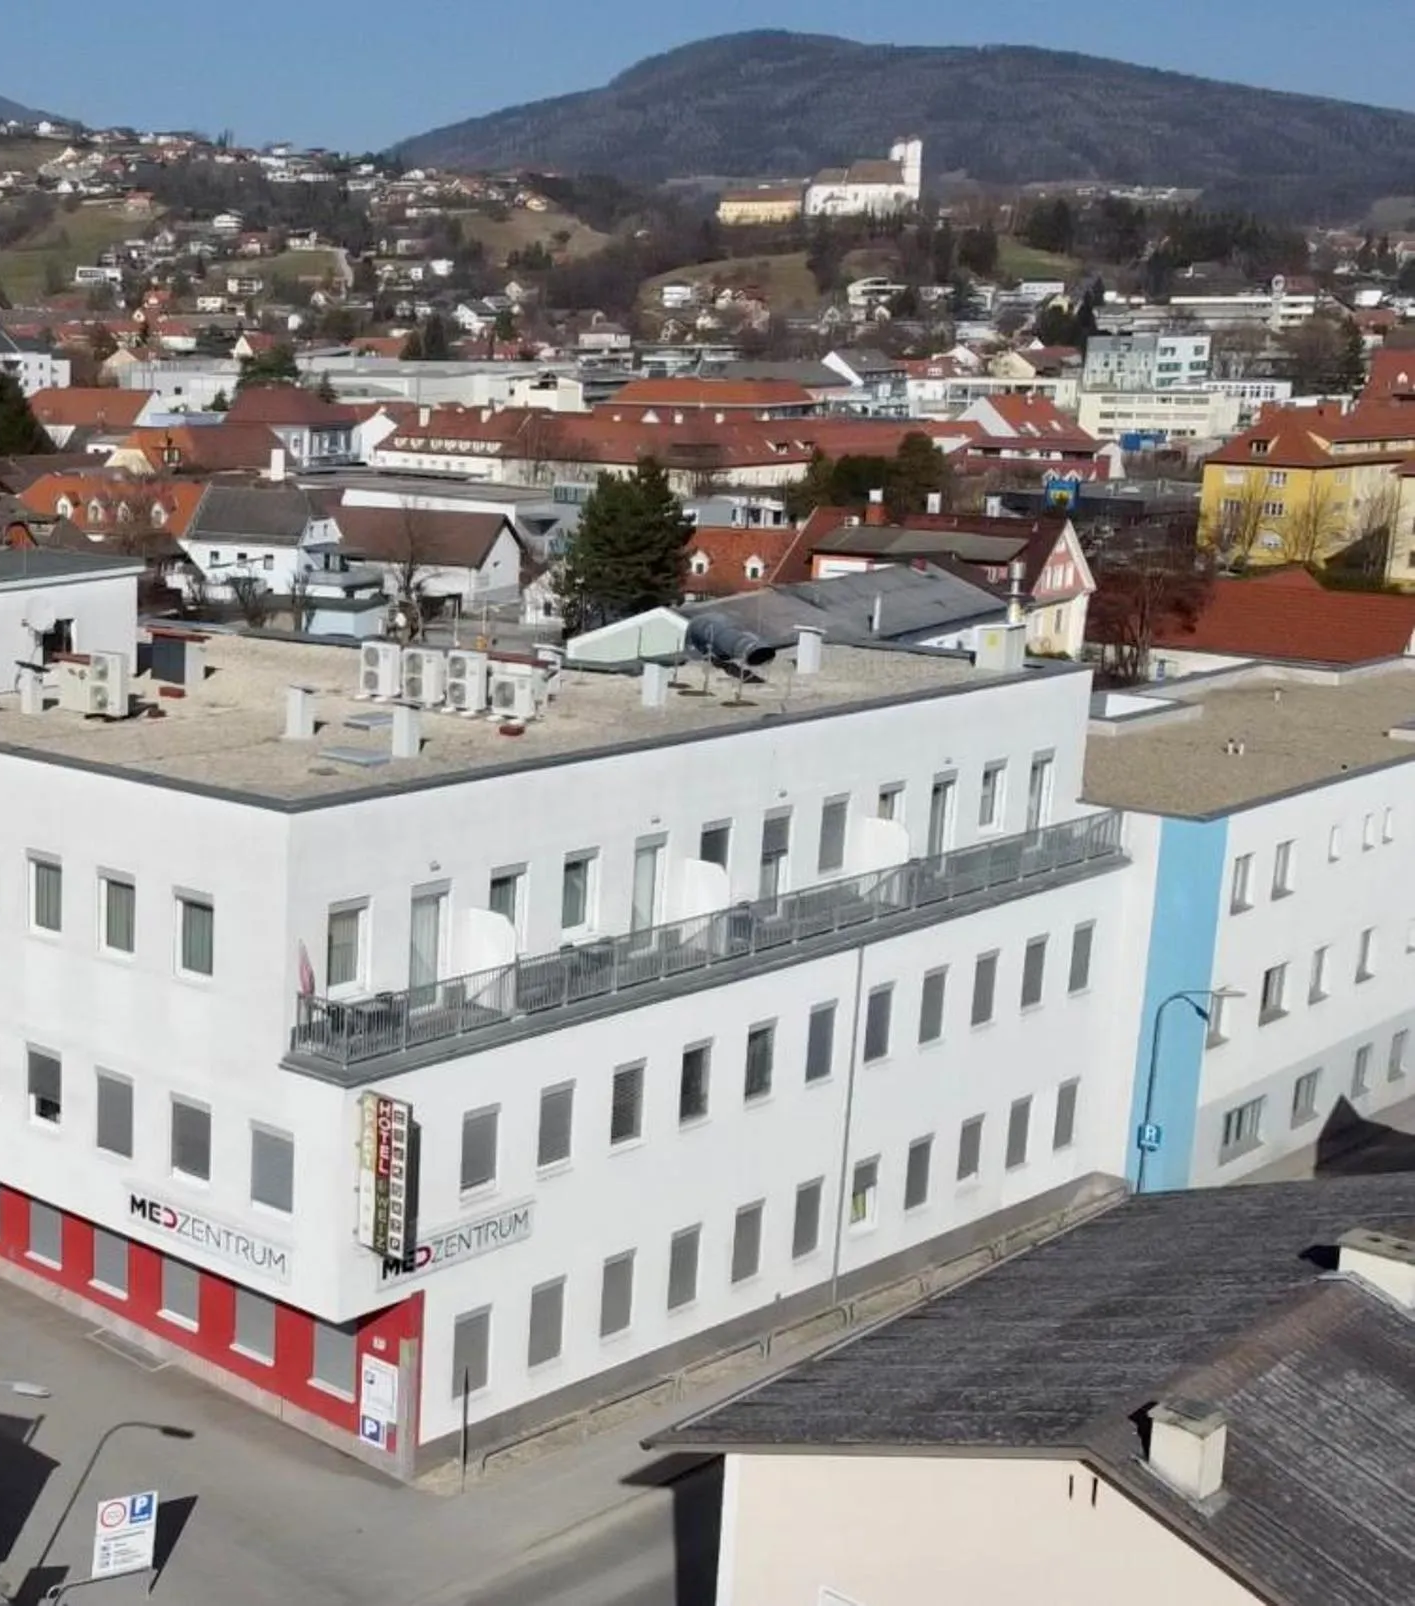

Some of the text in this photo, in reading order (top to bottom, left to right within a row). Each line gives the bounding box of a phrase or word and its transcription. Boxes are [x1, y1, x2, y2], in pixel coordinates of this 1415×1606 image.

[378, 1101, 393, 1176] HOTEL
[130, 1194, 286, 1275] MEDZENTRUM
[382, 1210, 529, 1280] MEDZENTRUM
[364, 1417, 378, 1436] P
[135, 1496, 149, 1515] P
